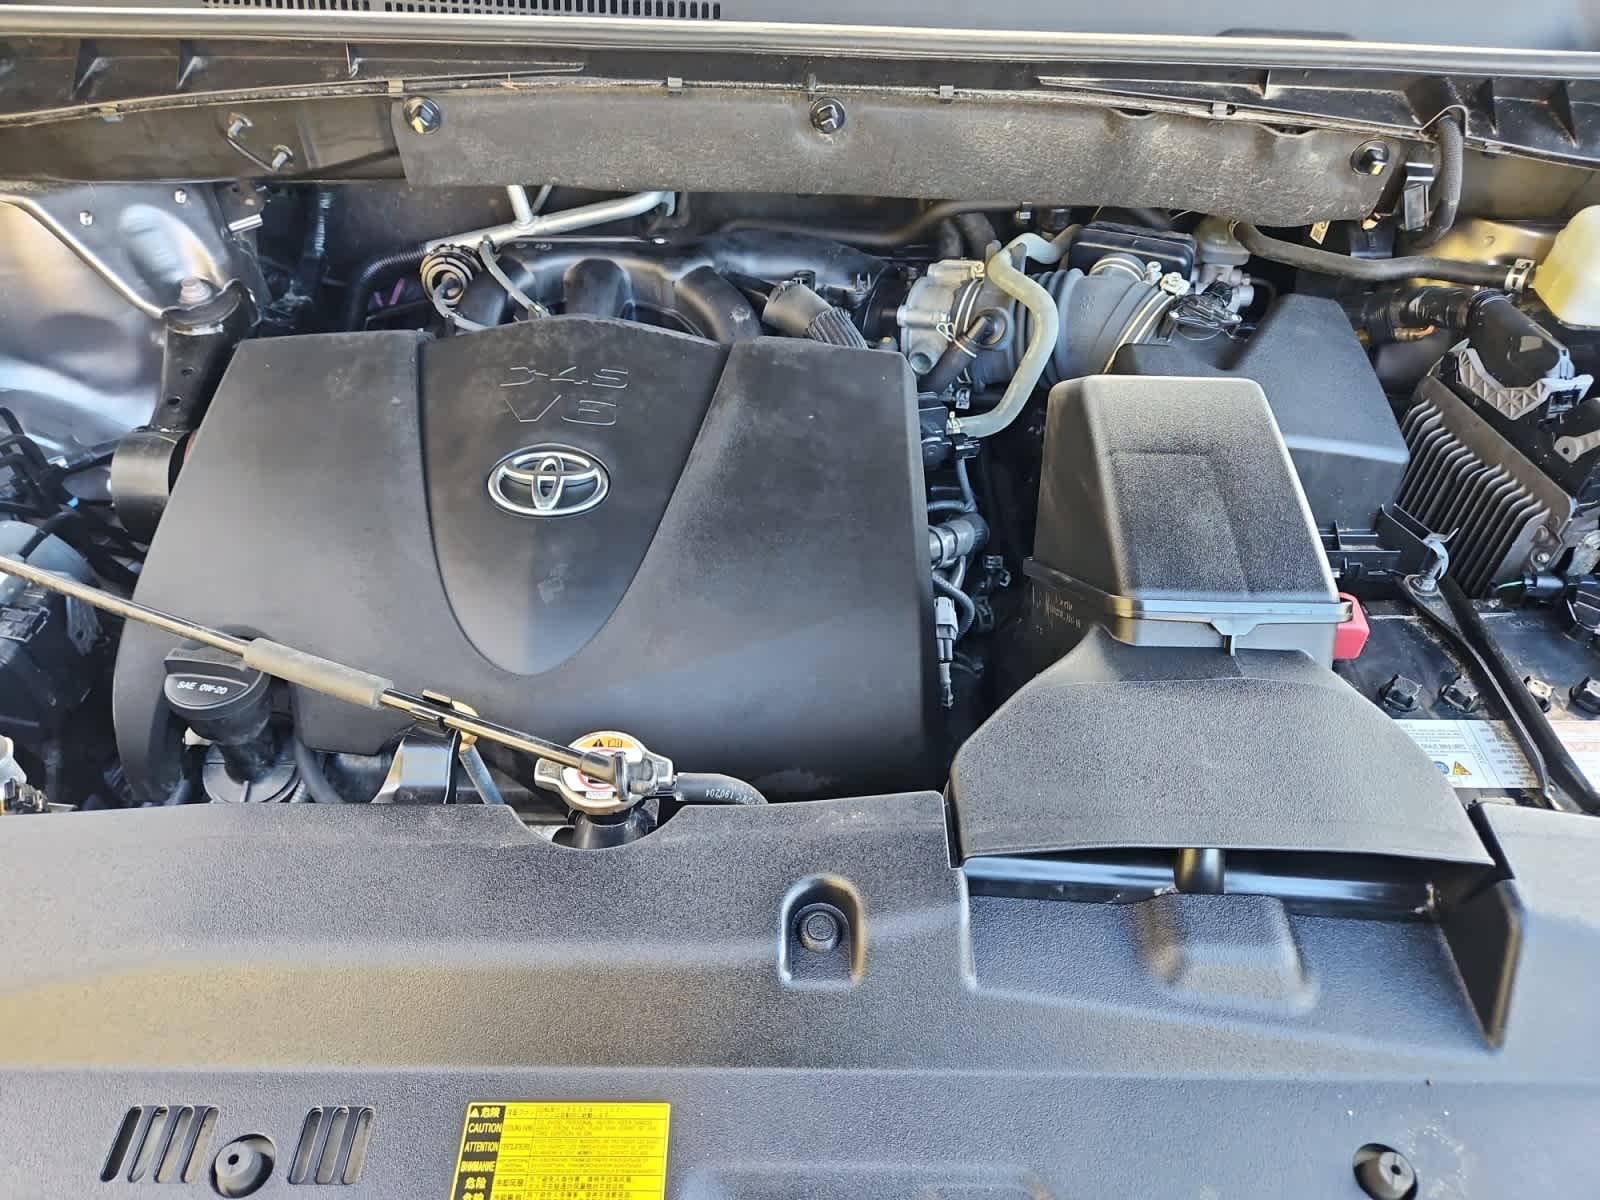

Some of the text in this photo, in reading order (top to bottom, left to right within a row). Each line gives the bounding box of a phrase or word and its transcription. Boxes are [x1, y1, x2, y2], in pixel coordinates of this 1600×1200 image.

[503, 393, 618, 426] V6
[177, 680, 198, 691] SAE
[468, 1122, 503, 1133] CAUTION
[464, 1141, 500, 1153] ATTENTION
